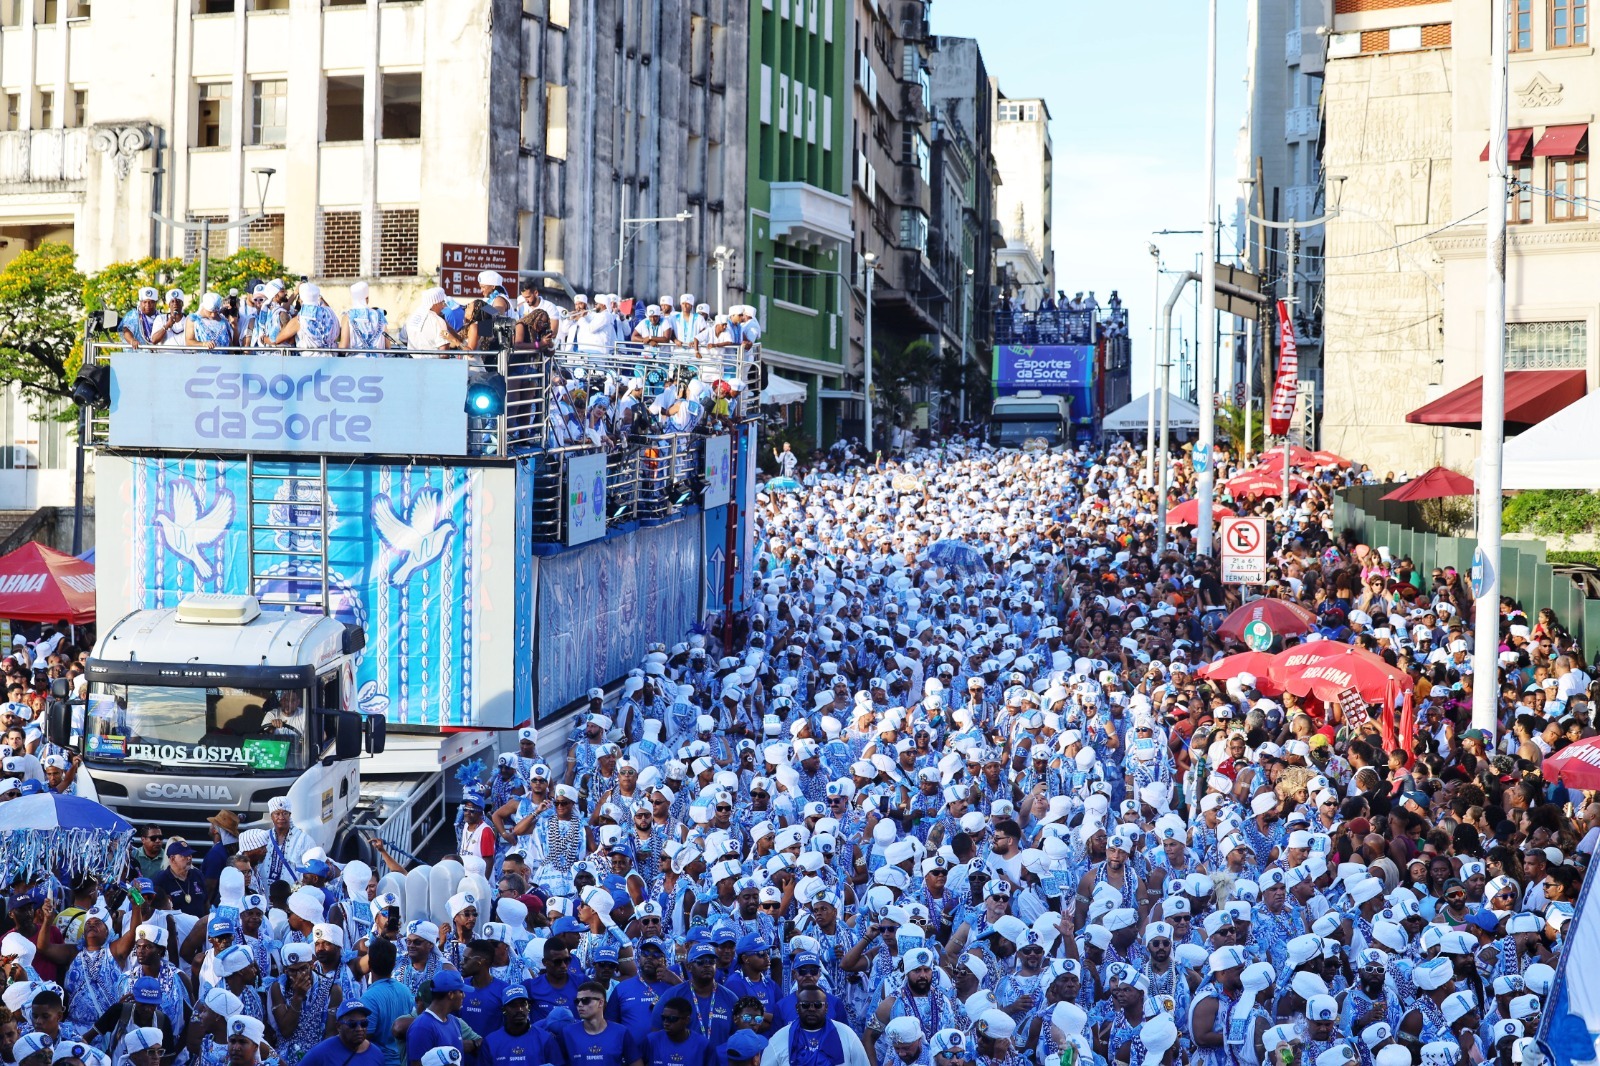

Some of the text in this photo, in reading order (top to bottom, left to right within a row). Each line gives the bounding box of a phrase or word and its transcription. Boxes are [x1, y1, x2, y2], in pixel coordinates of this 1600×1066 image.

[489, 248, 505, 256] Barra
[1013, 359, 1072, 371] Esportes
[1271, 319, 1298, 420] BRAHMA
[184, 365, 384, 410] Esportes
[1237, 528, 1250, 547] E
[1301, 666, 1353, 688] BRAHMA
[127, 744, 256, 763] TRIOS OSPAL
[145, 782, 232, 801] SCANIA
